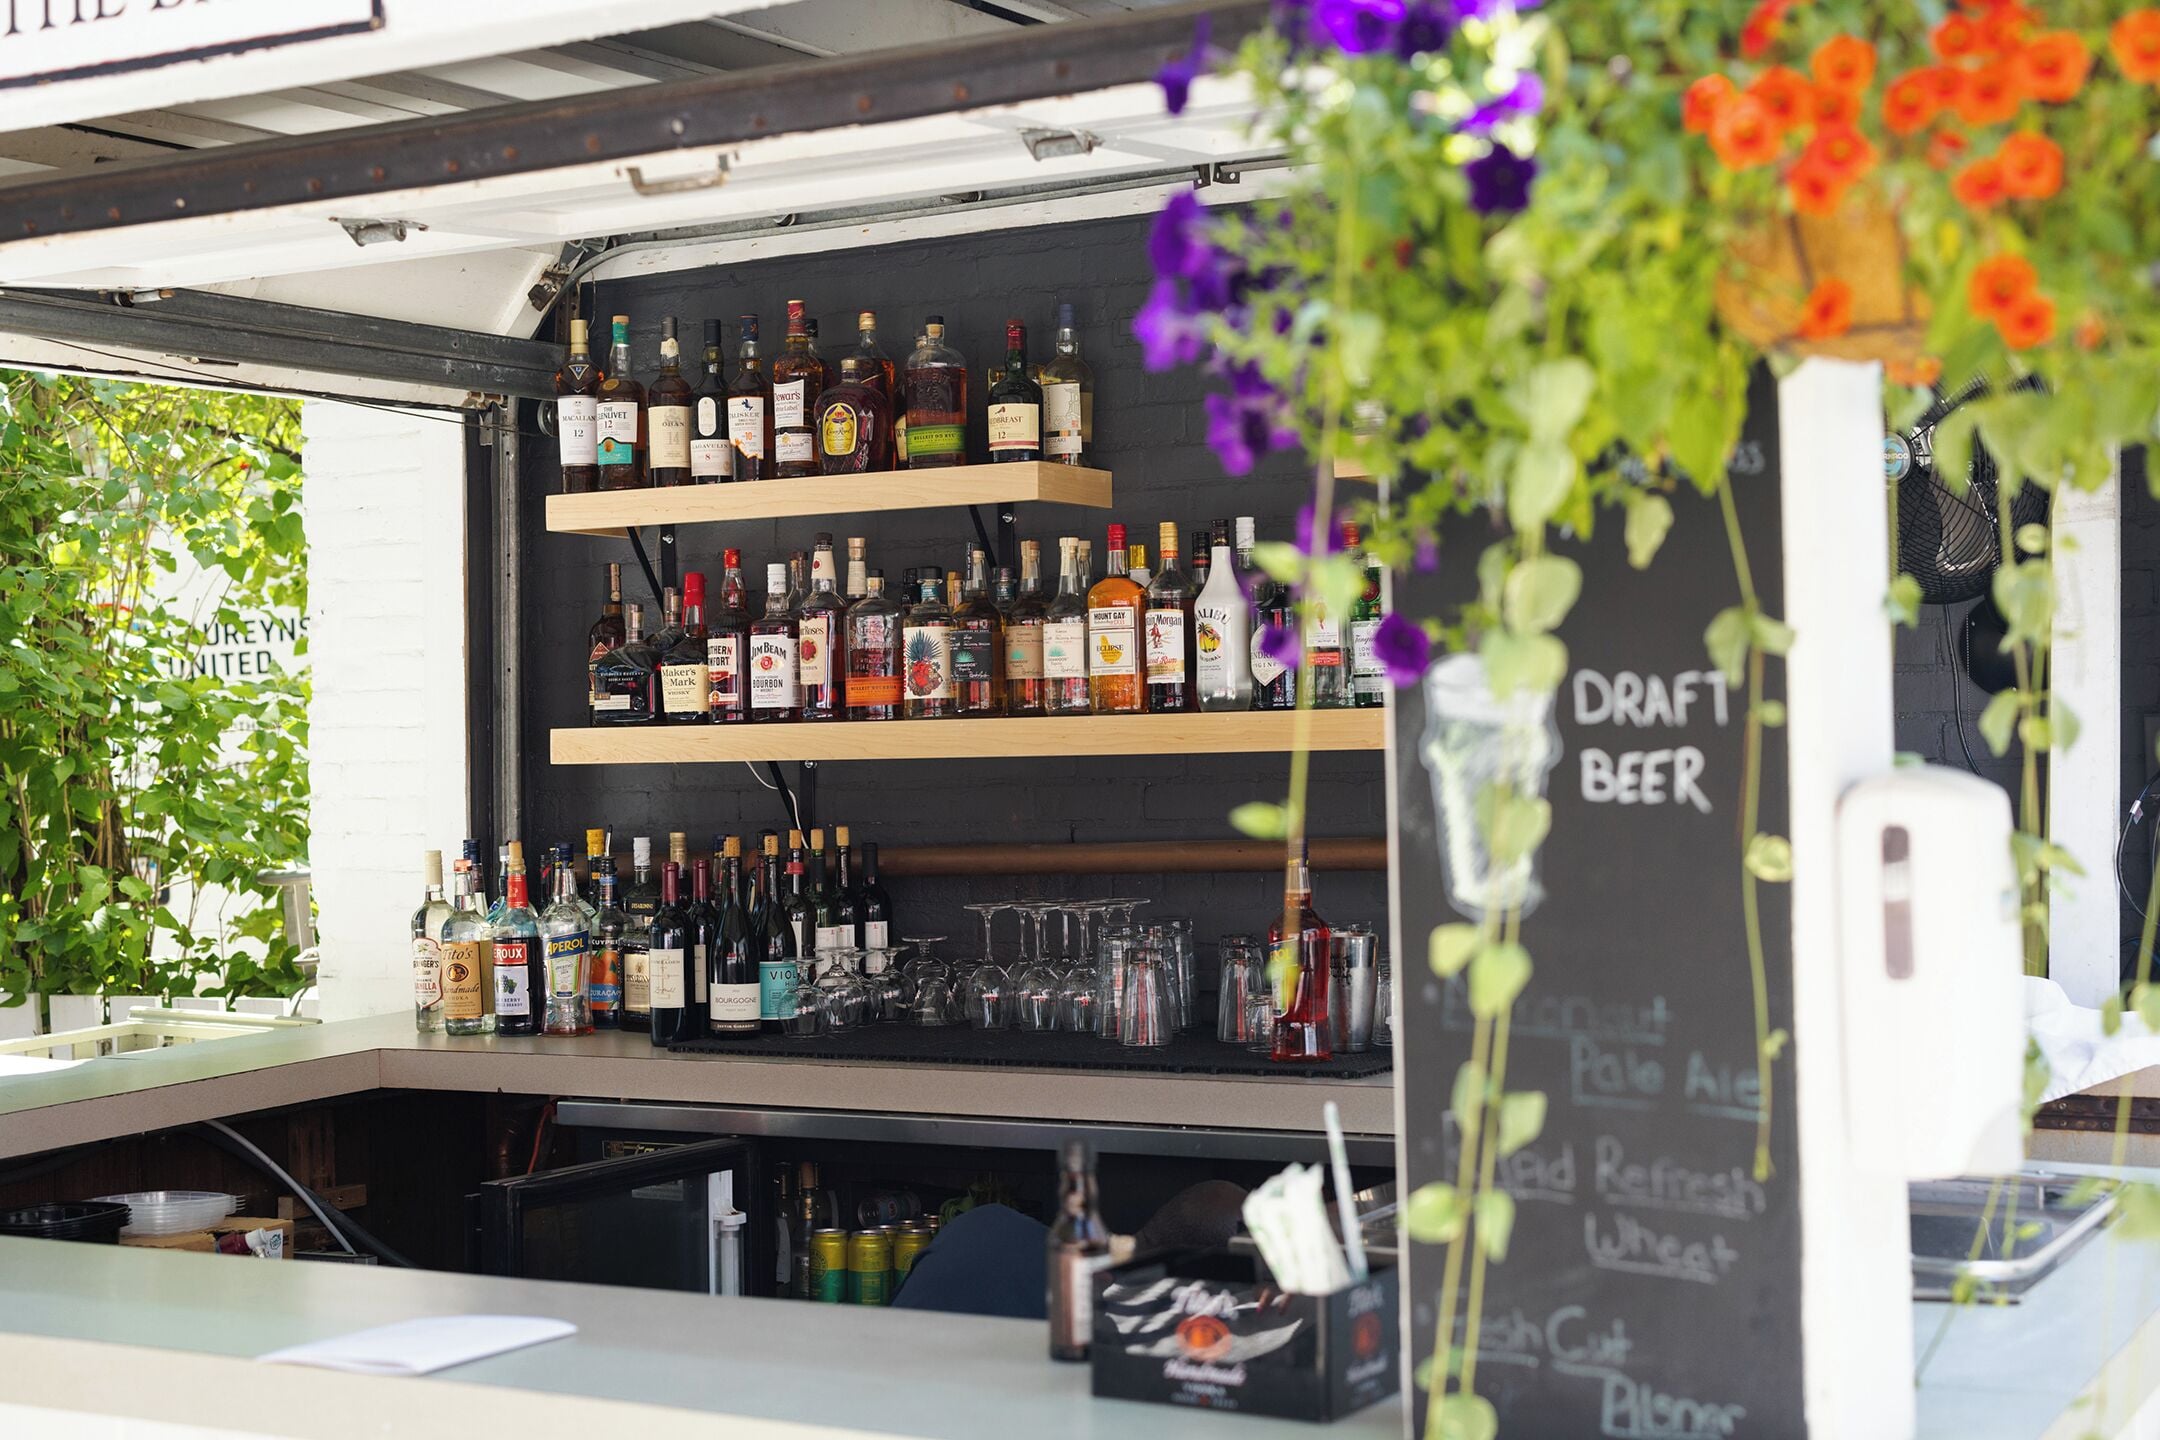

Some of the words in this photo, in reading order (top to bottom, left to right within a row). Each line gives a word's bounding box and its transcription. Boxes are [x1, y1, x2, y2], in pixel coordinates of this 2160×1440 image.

[604, 420, 613, 428] 12
[574, 429, 584, 438] 12
[745, 431, 753, 441] 10
[998, 431, 1007, 439] 12
[704, 453, 711, 461] 8
[1094, 613, 1112, 621] MOUNT
[1113, 612, 1126, 620] GAY
[1156, 613, 1183, 627] Morgan
[752, 645, 763, 661] JIM
[763, 641, 787, 660] BEAM
[1096, 644, 1124, 652] ECLIPSE
[662, 668, 697, 677] Maker's
[670, 677, 697, 687] Mark
[753, 679, 784, 689] BOURBON
[1573, 668, 1729, 728] DRAFT
[1580, 746, 1713, 814] BEER
[547, 938, 584, 955] APEROL
[442, 947, 473, 960] Tito's
[1584, 1211, 1739, 1276] Wheat
